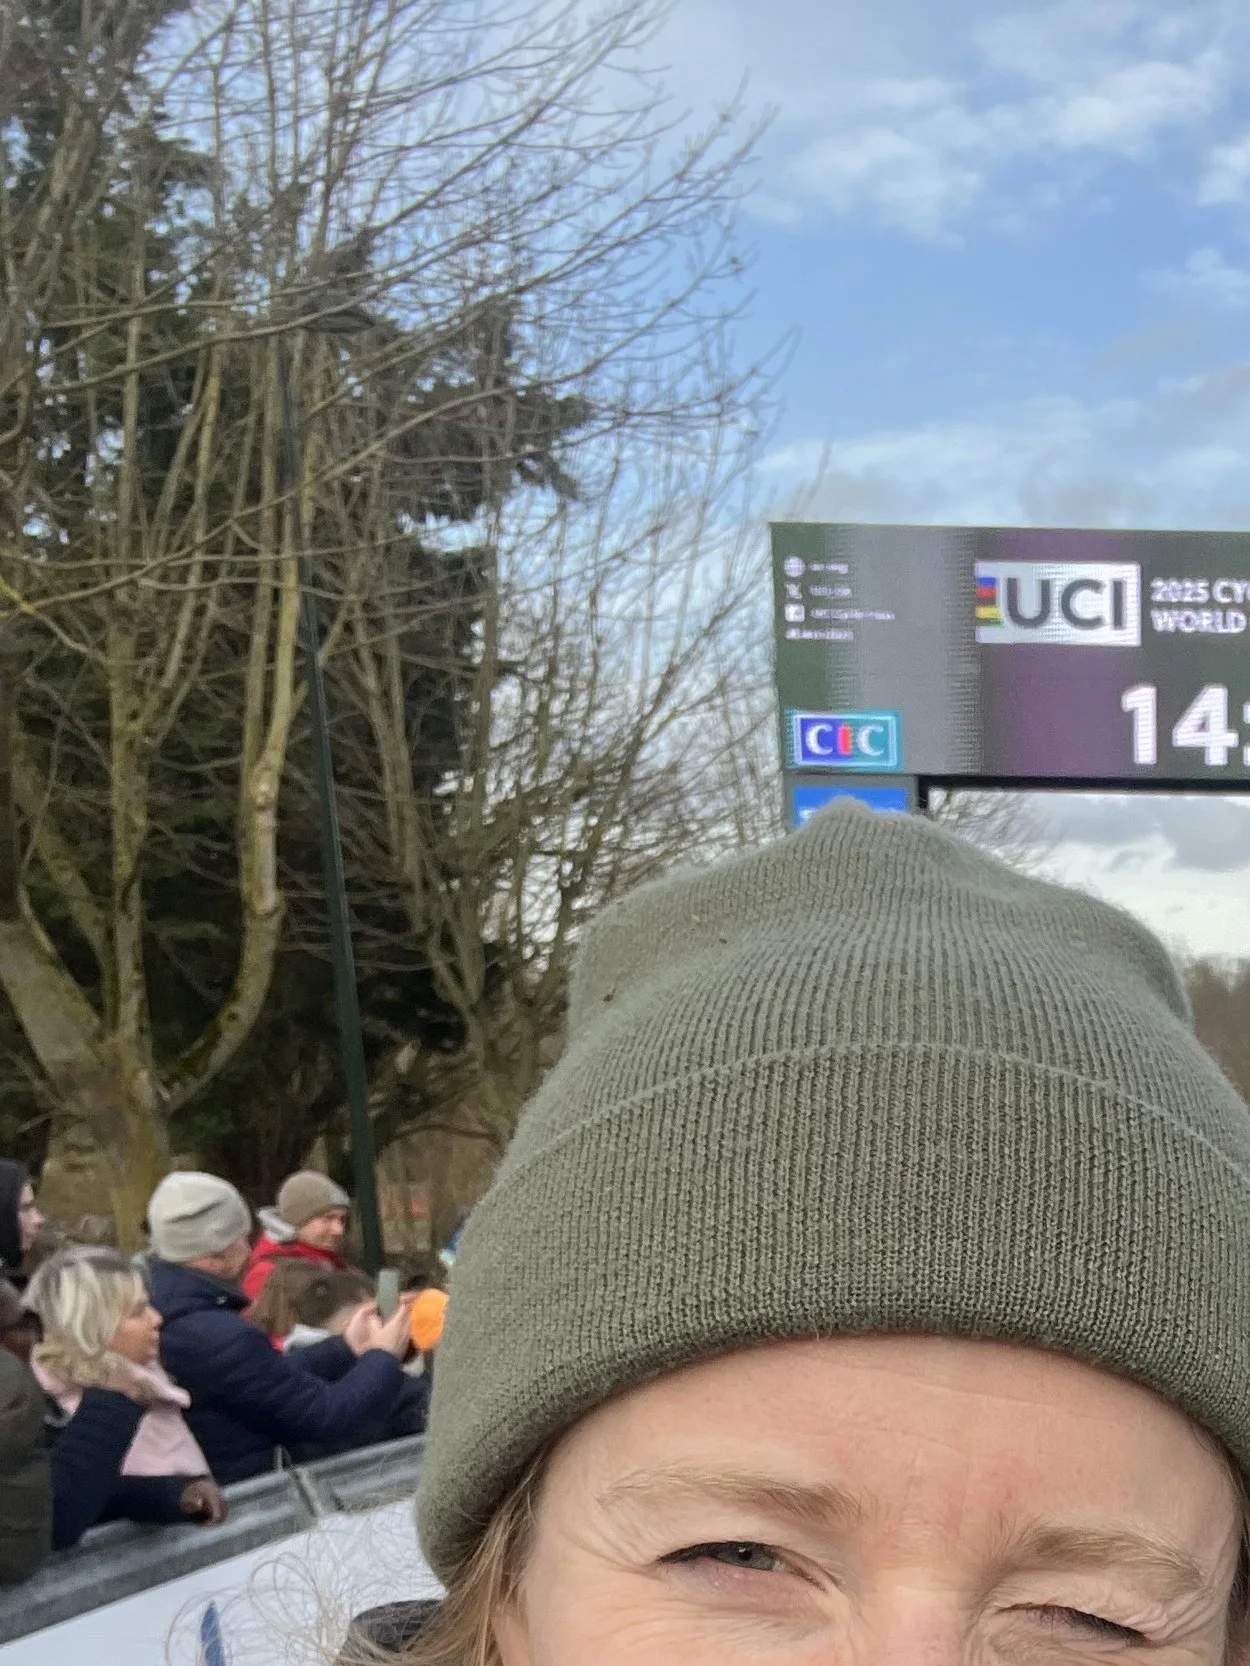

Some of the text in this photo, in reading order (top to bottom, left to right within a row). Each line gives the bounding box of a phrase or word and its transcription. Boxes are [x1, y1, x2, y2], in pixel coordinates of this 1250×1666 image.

[1007, 578, 1124, 631] UCI
[1150, 577, 1209, 603] 2025
[1150, 609, 1247, 633] WORLD
[805, 724, 885, 756] CIC
